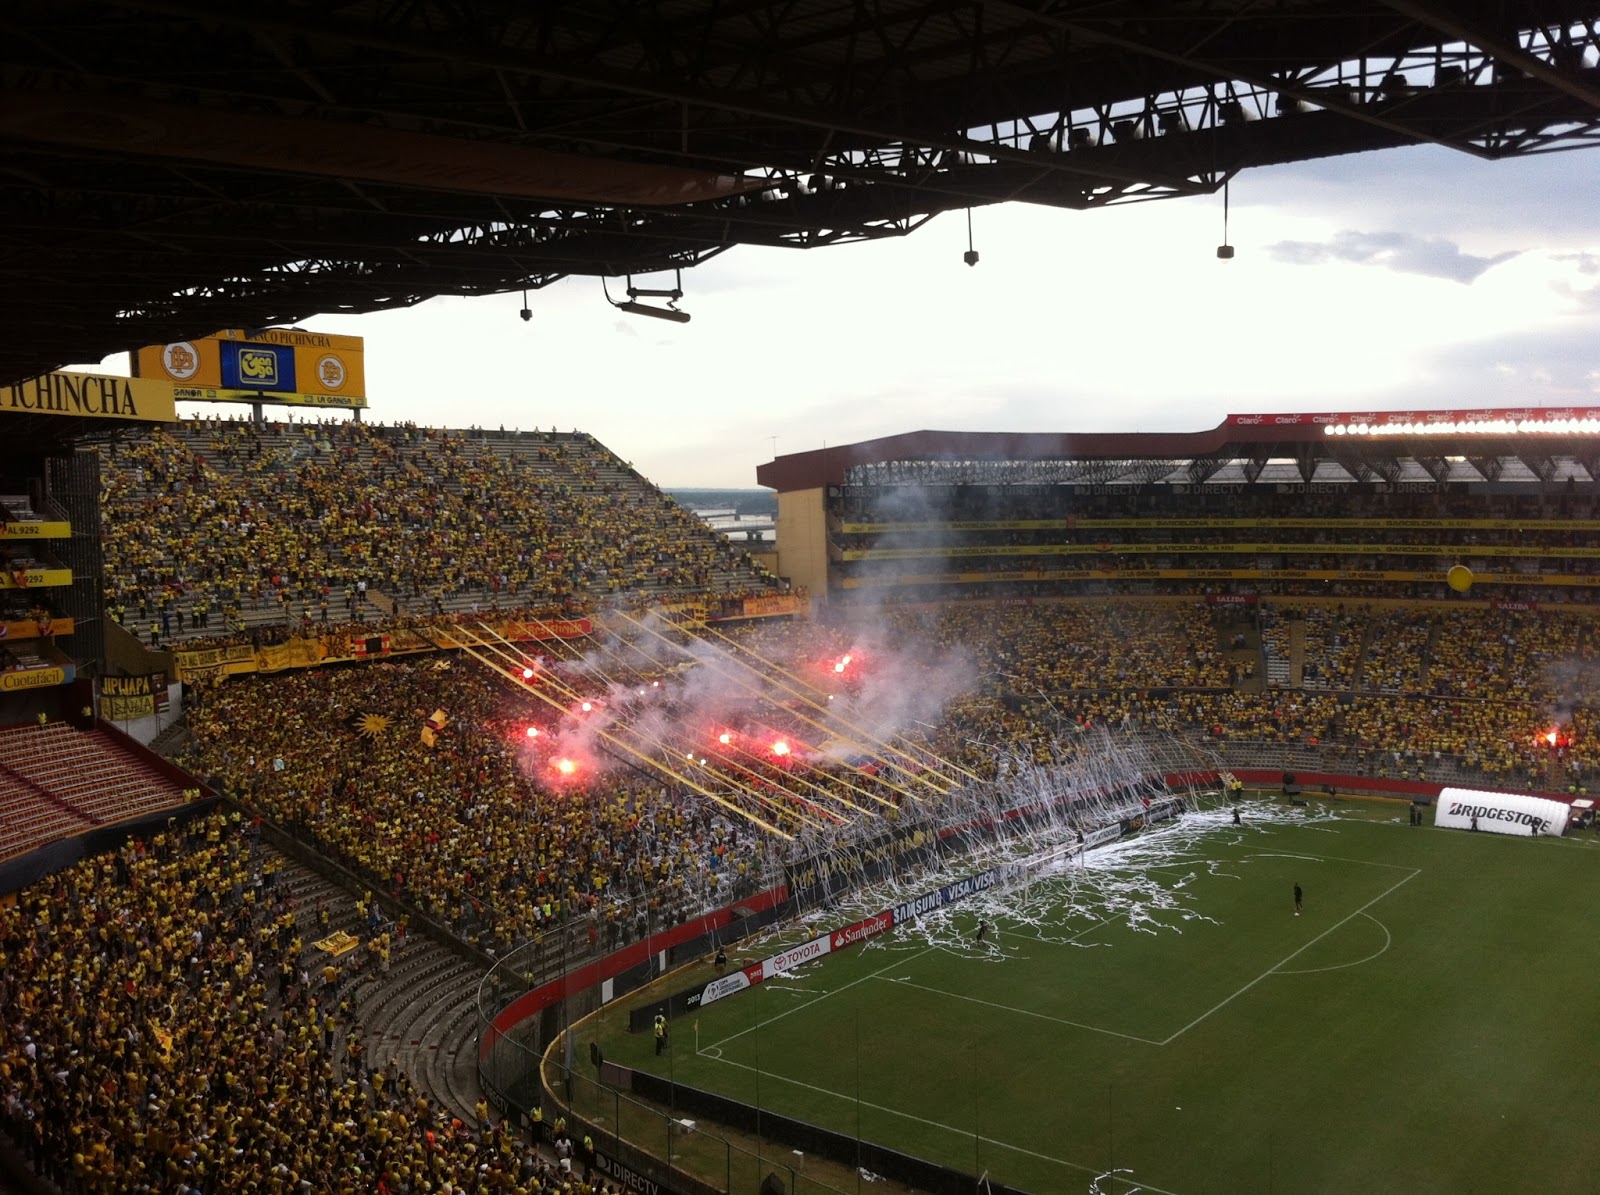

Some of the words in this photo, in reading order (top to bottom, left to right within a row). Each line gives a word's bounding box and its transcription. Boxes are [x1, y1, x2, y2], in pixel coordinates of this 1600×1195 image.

[280, 333, 331, 348] PICHINCHA
[317, 396, 327, 404] LA
[1312, 415, 1335, 424] Claro
[1350, 414, 1372, 423] Claro
[1388, 414, 1411, 423] Claro
[1426, 413, 1449, 422] Claro
[1465, 412, 1488, 421] Claro
[1505, 411, 1528, 420] Claro
[1545, 410, 1569, 420] Claro
[1237, 416, 1260, 425] Claro
[1275, 416, 1298, 425] Claro
[1093, 484, 1142, 495] DIRECTV
[1194, 483, 1244, 495] DIRECTV
[1298, 483, 1350, 494] DIRECTV
[1397, 482, 1450, 494] DIRECTV
[8, 526, 18, 535] AL
[19, 526, 39, 534] 9292
[24, 575, 44, 583] 9292
[1497, 602, 1529, 610] SALIDA
[4, 669, 60, 686] Cuotafácil
[102, 676, 150, 696] JIPIJAPA
[893, 890, 943, 925] SAMSUNG
[844, 918, 888, 943] Santander
[786, 943, 820, 965] TOYOTA
[686, 994, 701, 1005] 2013
[613, 1163, 659, 1195] DIRECTV
